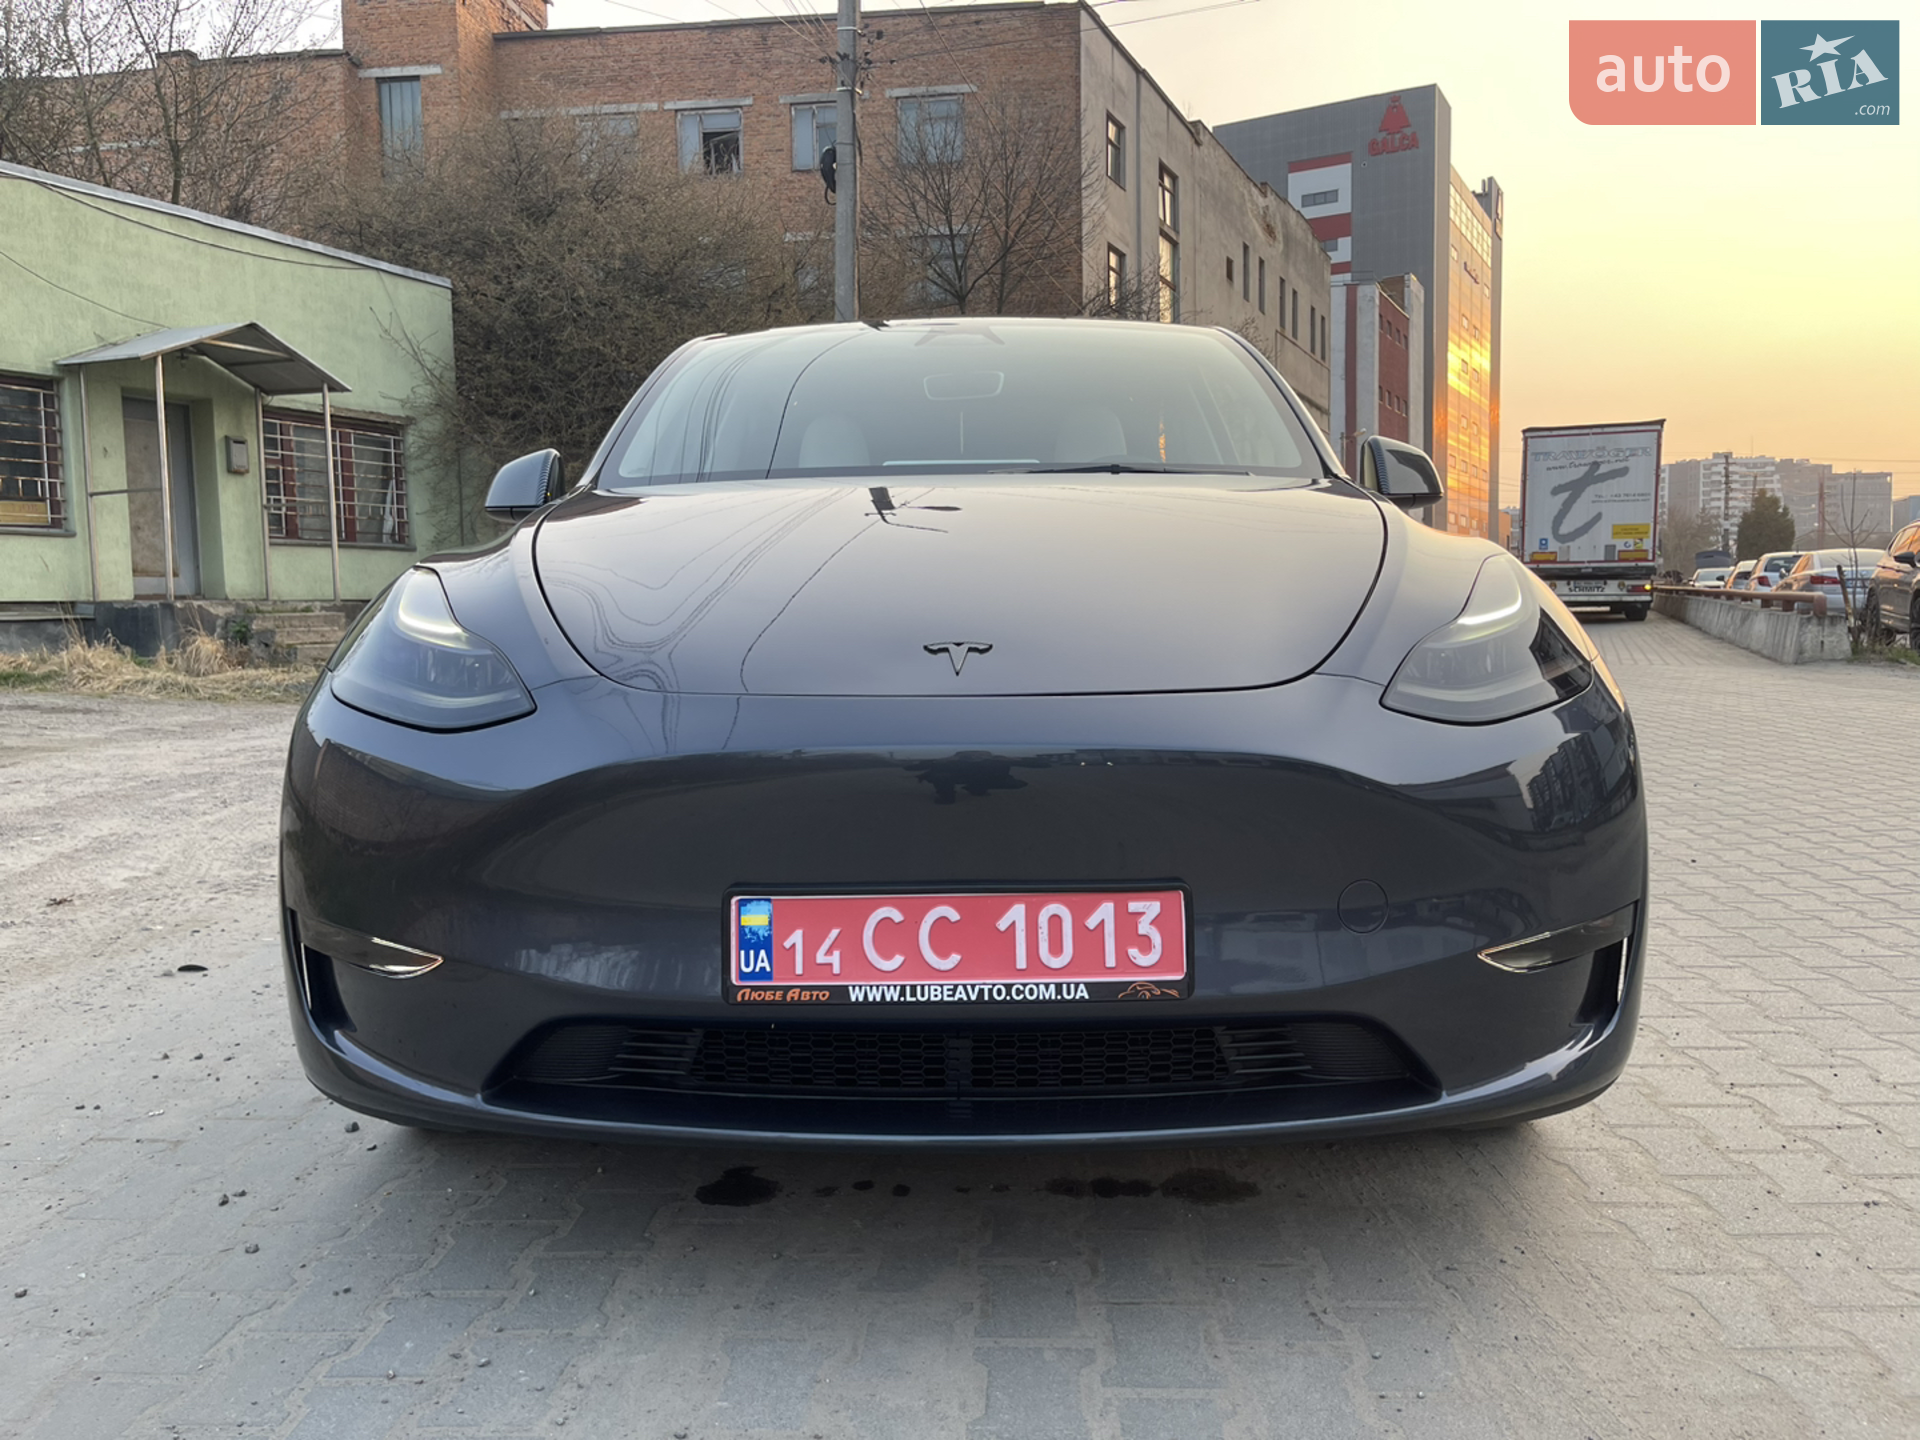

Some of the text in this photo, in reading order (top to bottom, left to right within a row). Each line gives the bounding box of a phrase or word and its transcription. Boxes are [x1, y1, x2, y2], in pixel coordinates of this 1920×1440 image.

[1368, 131, 1420, 156] GALCA
[783, 901, 1163, 975] 14 CC 1013
[739, 949, 771, 973] UA
[848, 983, 1089, 1002] WWW.LUBEAVTO.COM.UA
